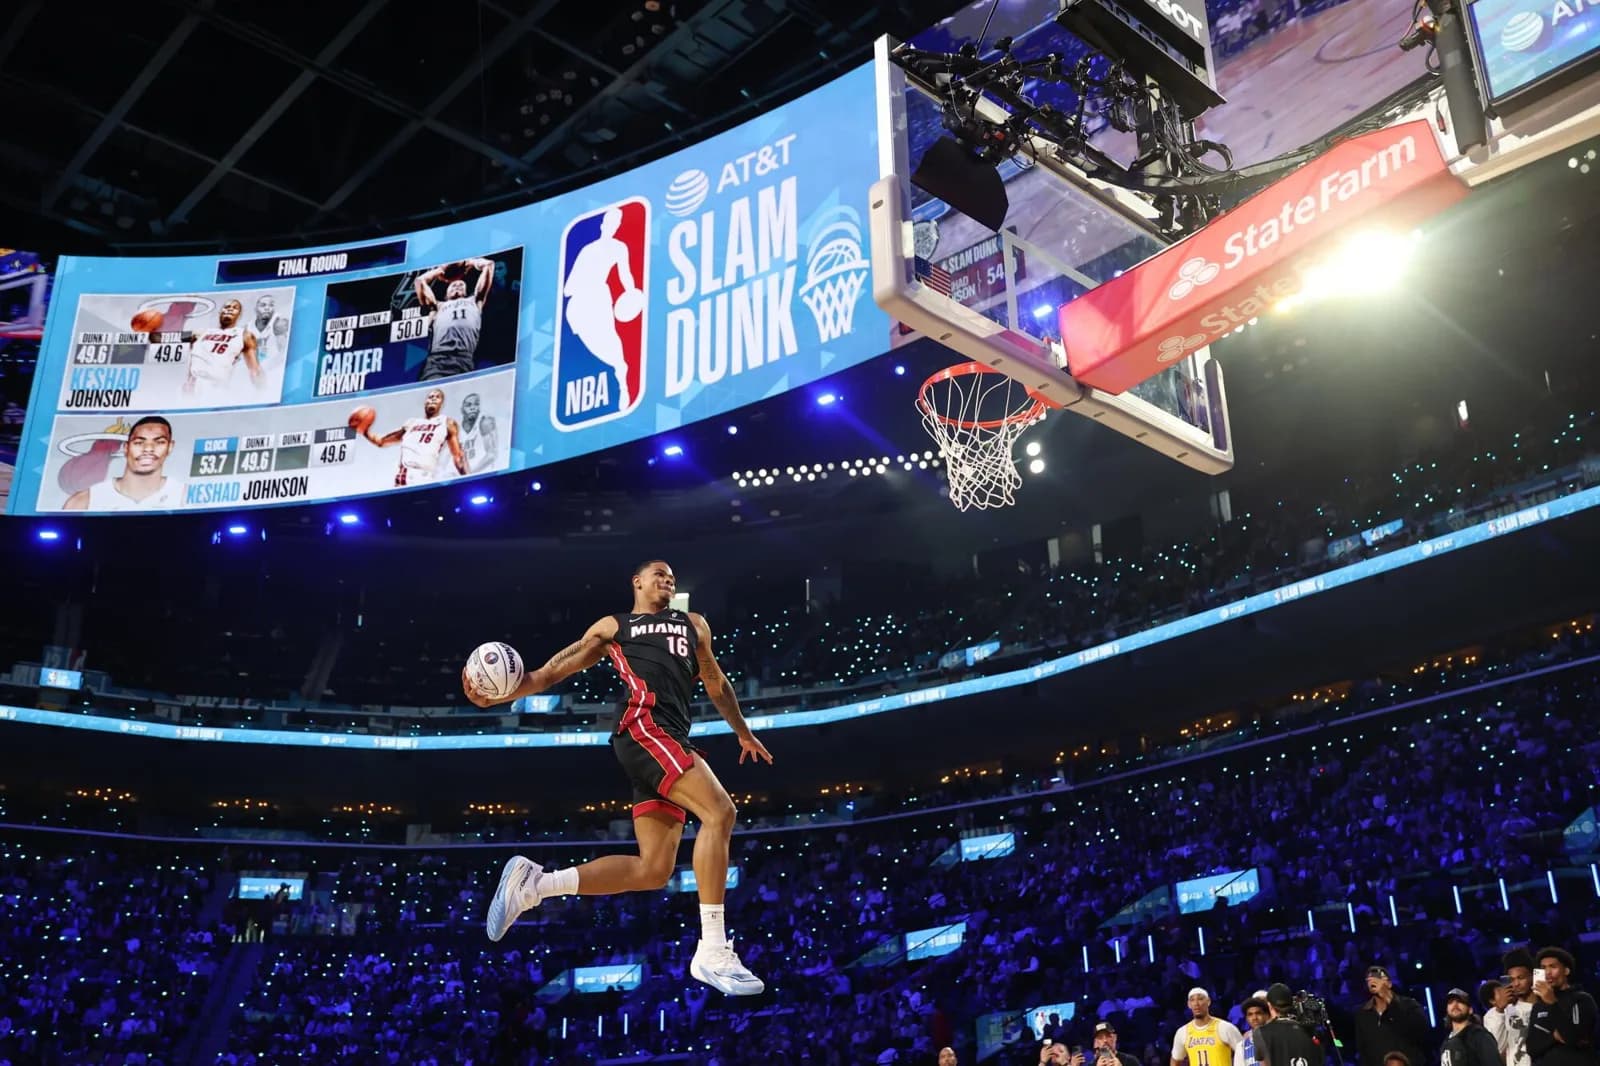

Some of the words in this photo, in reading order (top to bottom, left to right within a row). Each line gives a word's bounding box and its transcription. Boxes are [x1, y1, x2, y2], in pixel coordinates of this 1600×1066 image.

[716, 133, 797, 194] AT&T
[666, 175, 797, 306] SLAM
[277, 257, 308, 277] FINAL
[310, 253, 348, 272] ROUND
[948, 248, 973, 274] SLAM
[973, 236, 998, 262] DUNK
[330, 319, 348, 330] DUNK
[397, 319, 423, 340] 50.0
[665, 265, 798, 399] DUNK
[82, 333, 104, 343] DUNK
[105, 333, 109, 343] 1
[118, 333, 138, 343] DUNK
[138, 333, 146, 343] 2
[325, 329, 354, 351] 50.0
[76, 344, 108, 364] 49.6
[154, 345, 183, 363] 49.6
[211, 343, 229, 355] 16
[320, 347, 384, 376] CARTER
[70, 367, 141, 391] KESHAD
[318, 371, 368, 396] BRYANT
[65, 389, 132, 408] JOHNSON
[564, 371, 609, 417] NBA
[246, 438, 265, 448] DUNK
[266, 437, 270, 447] 1
[282, 434, 301, 446] DUNK
[302, 433, 308, 444] 2
[326, 429, 346, 441] TOTAL
[419, 432, 434, 444] 16
[204, 439, 228, 452] CLOCK
[320, 444, 347, 464] 49.6
[199, 454, 227, 475] 53.7
[241, 452, 269, 472] 49.6
[186, 481, 241, 505] KESHAD
[243, 476, 309, 501] JOHNSON
[631, 622, 688, 638] MIAMI
[667, 635, 688, 657] 16
